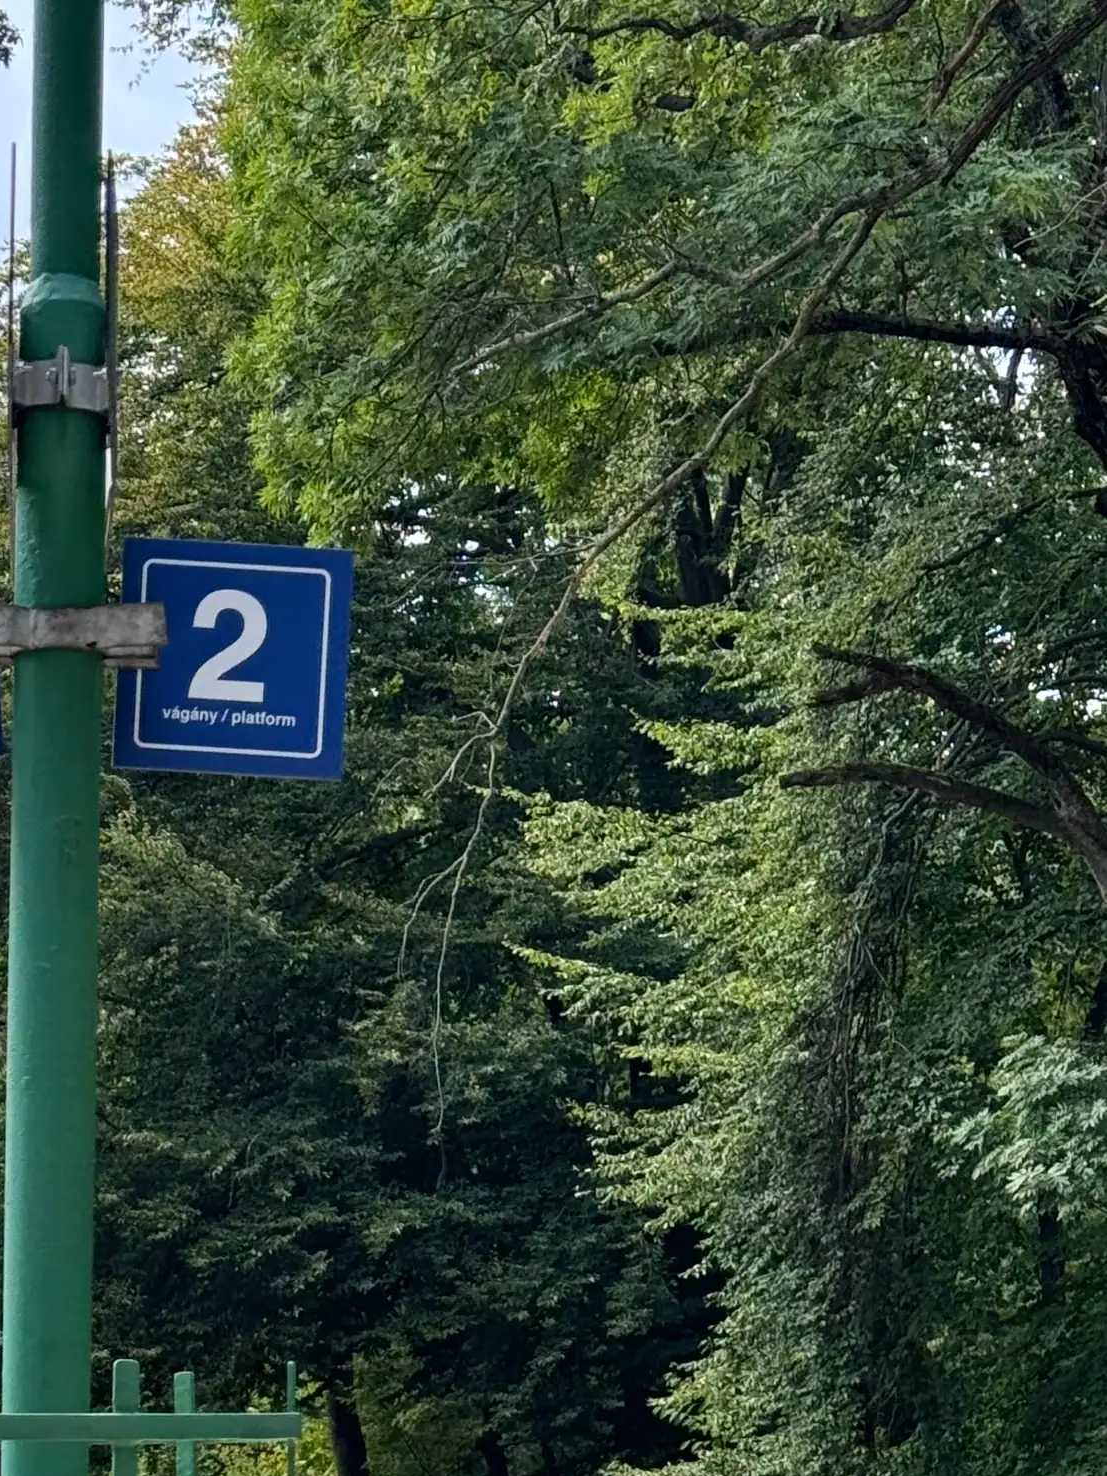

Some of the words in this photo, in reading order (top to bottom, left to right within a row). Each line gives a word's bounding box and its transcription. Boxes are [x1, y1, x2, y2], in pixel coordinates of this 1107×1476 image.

[187, 589, 267, 703] 2
[162, 705, 218, 725] vágány
[221, 708, 230, 722] /
[231, 709, 297, 727] platform
